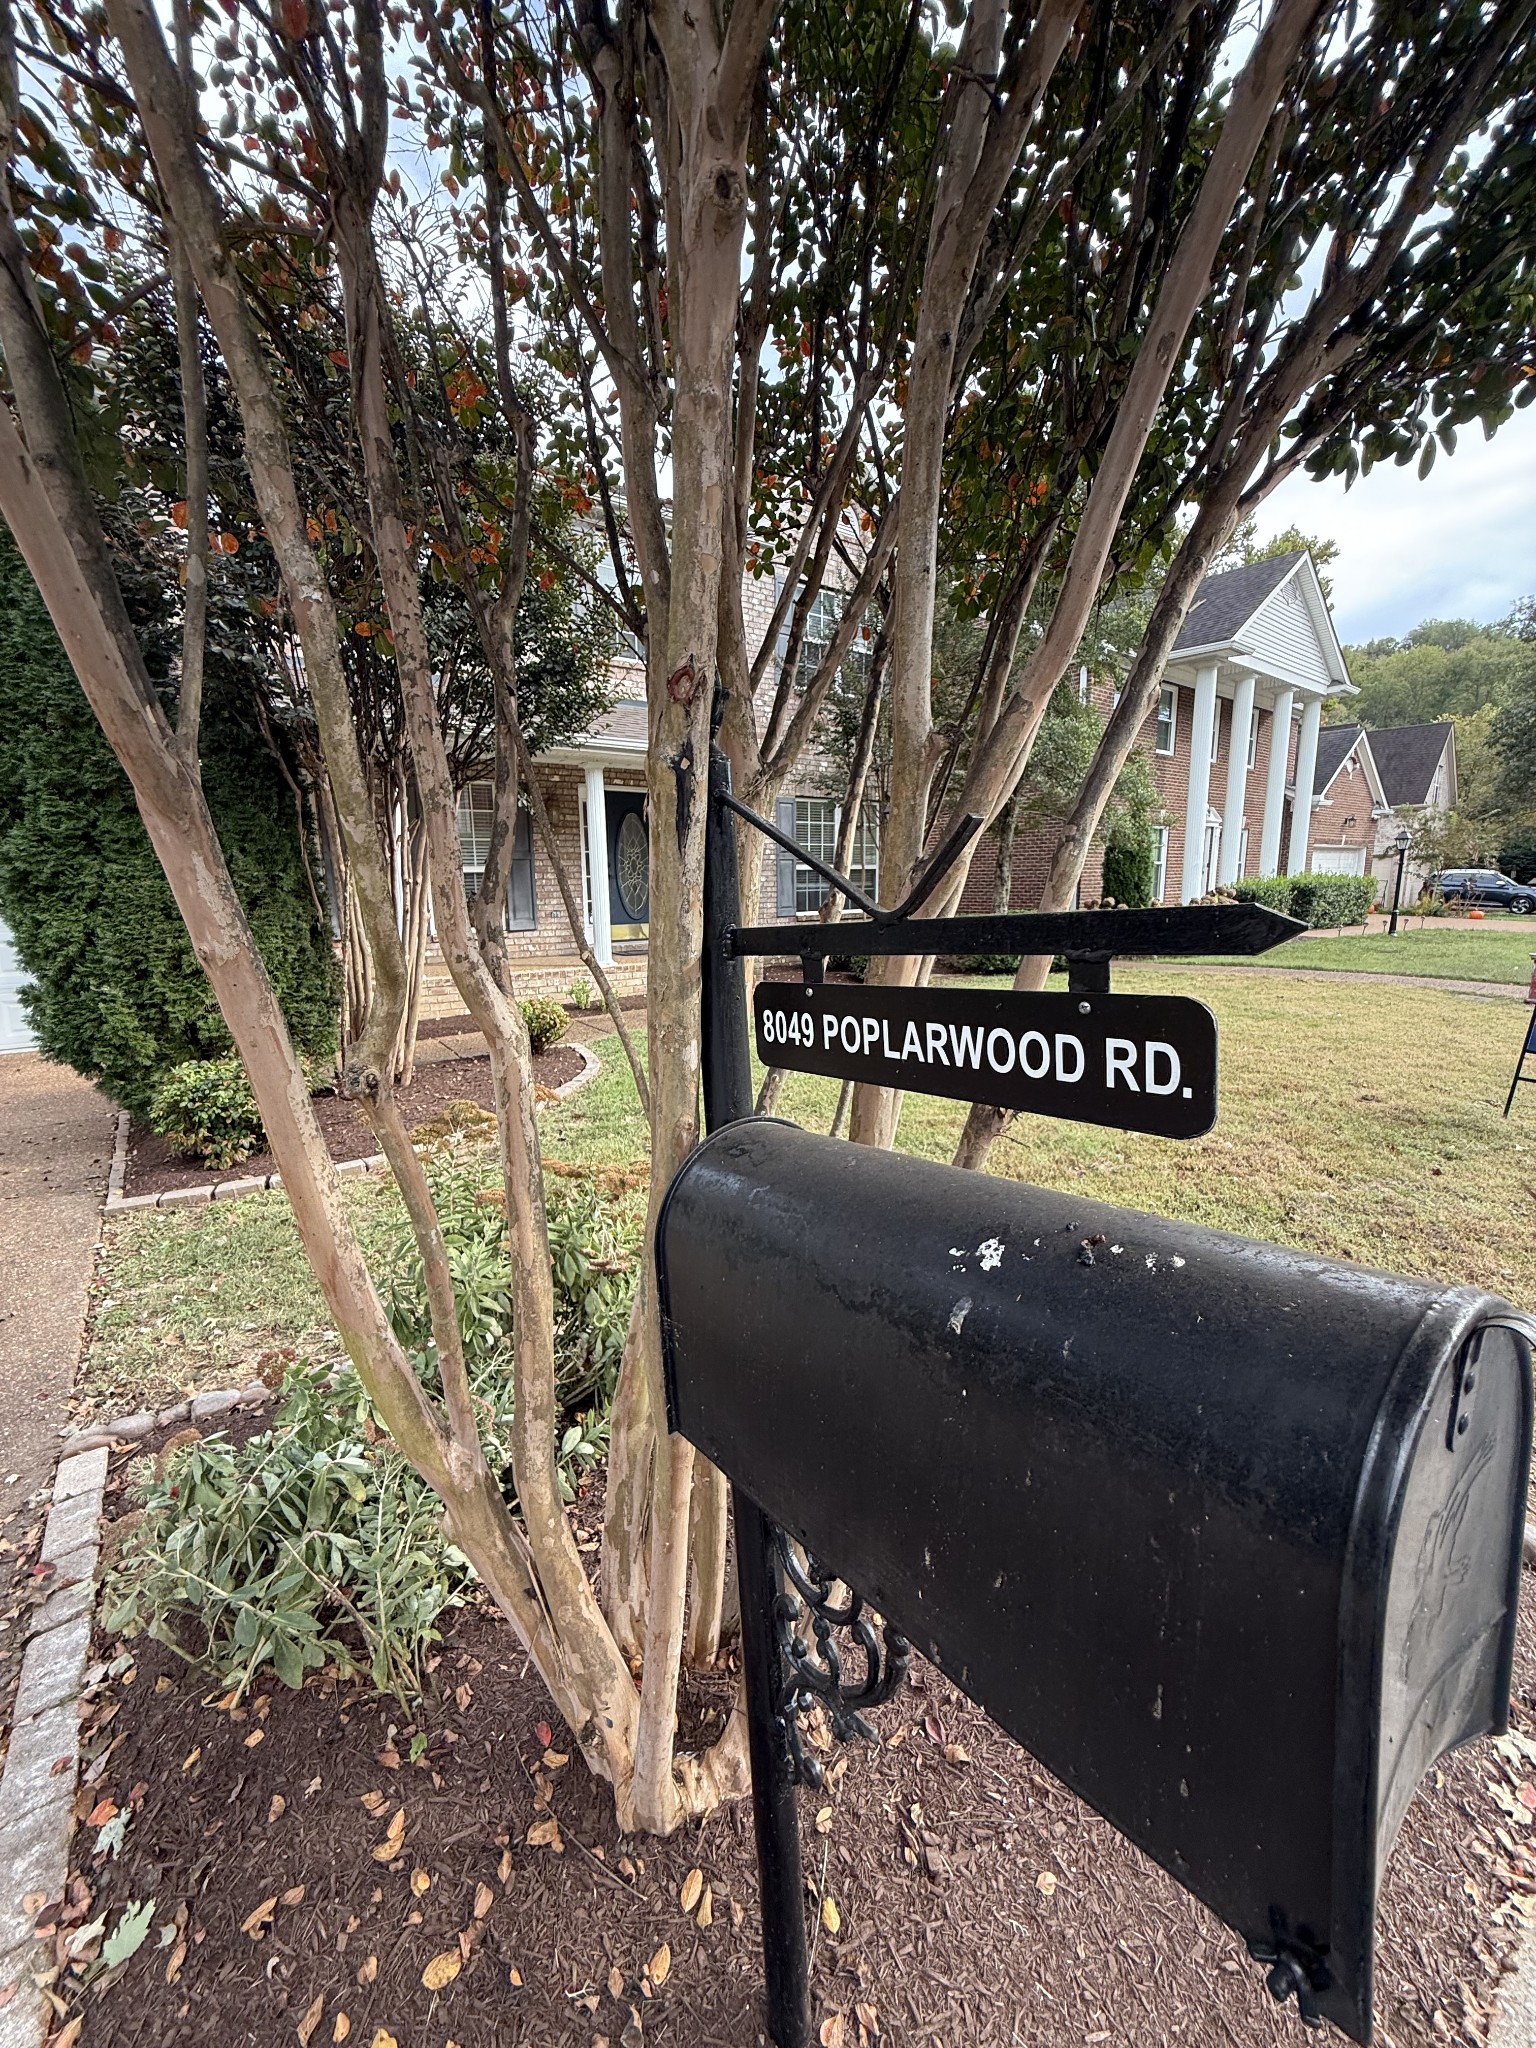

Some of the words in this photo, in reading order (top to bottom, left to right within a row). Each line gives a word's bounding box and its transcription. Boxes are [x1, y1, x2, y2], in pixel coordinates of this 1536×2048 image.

[762, 1009, 815, 1048] 8049
[822, 1013, 1085, 1083] POPLARWOOD
[1105, 1037, 1193, 1099] RD.
